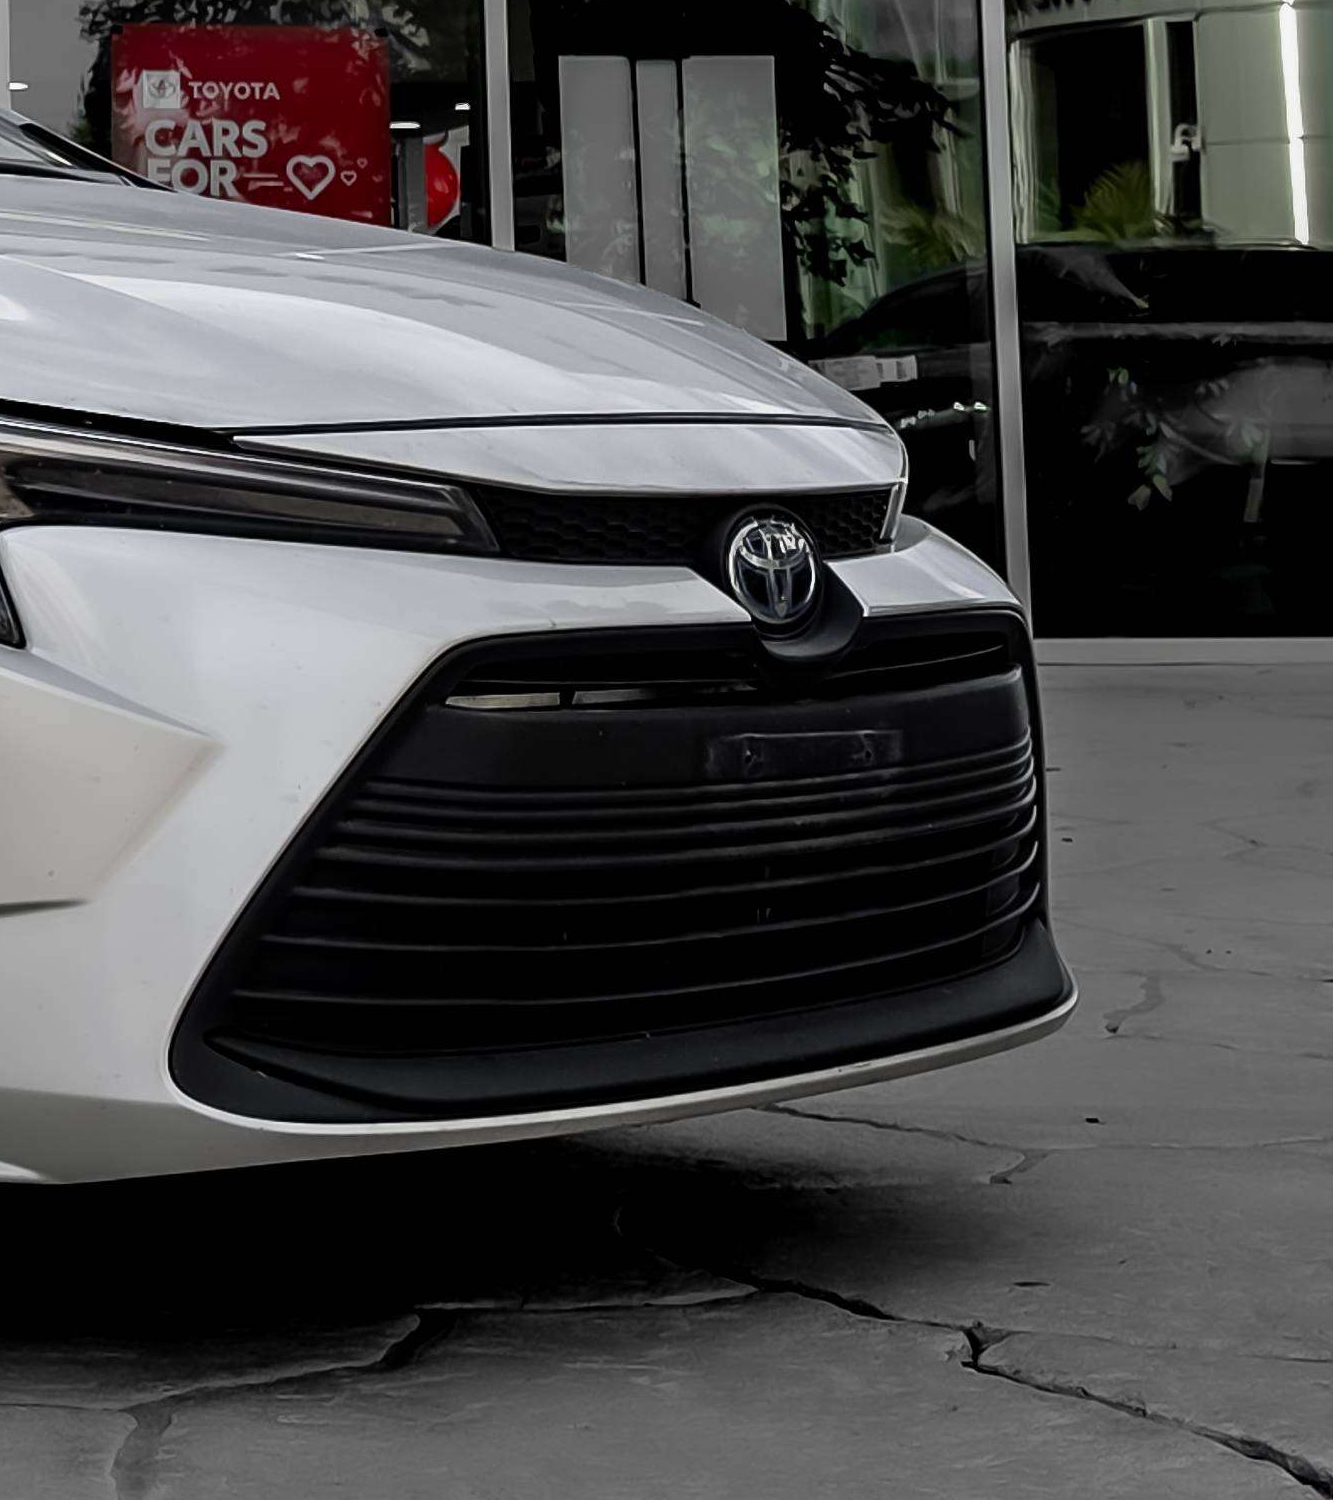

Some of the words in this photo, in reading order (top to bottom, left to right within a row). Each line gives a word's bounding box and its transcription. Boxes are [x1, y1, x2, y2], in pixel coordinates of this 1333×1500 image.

[188, 80, 281, 101] TOYOTA
[144, 118, 269, 158] CARS
[147, 158, 243, 198] FOR
